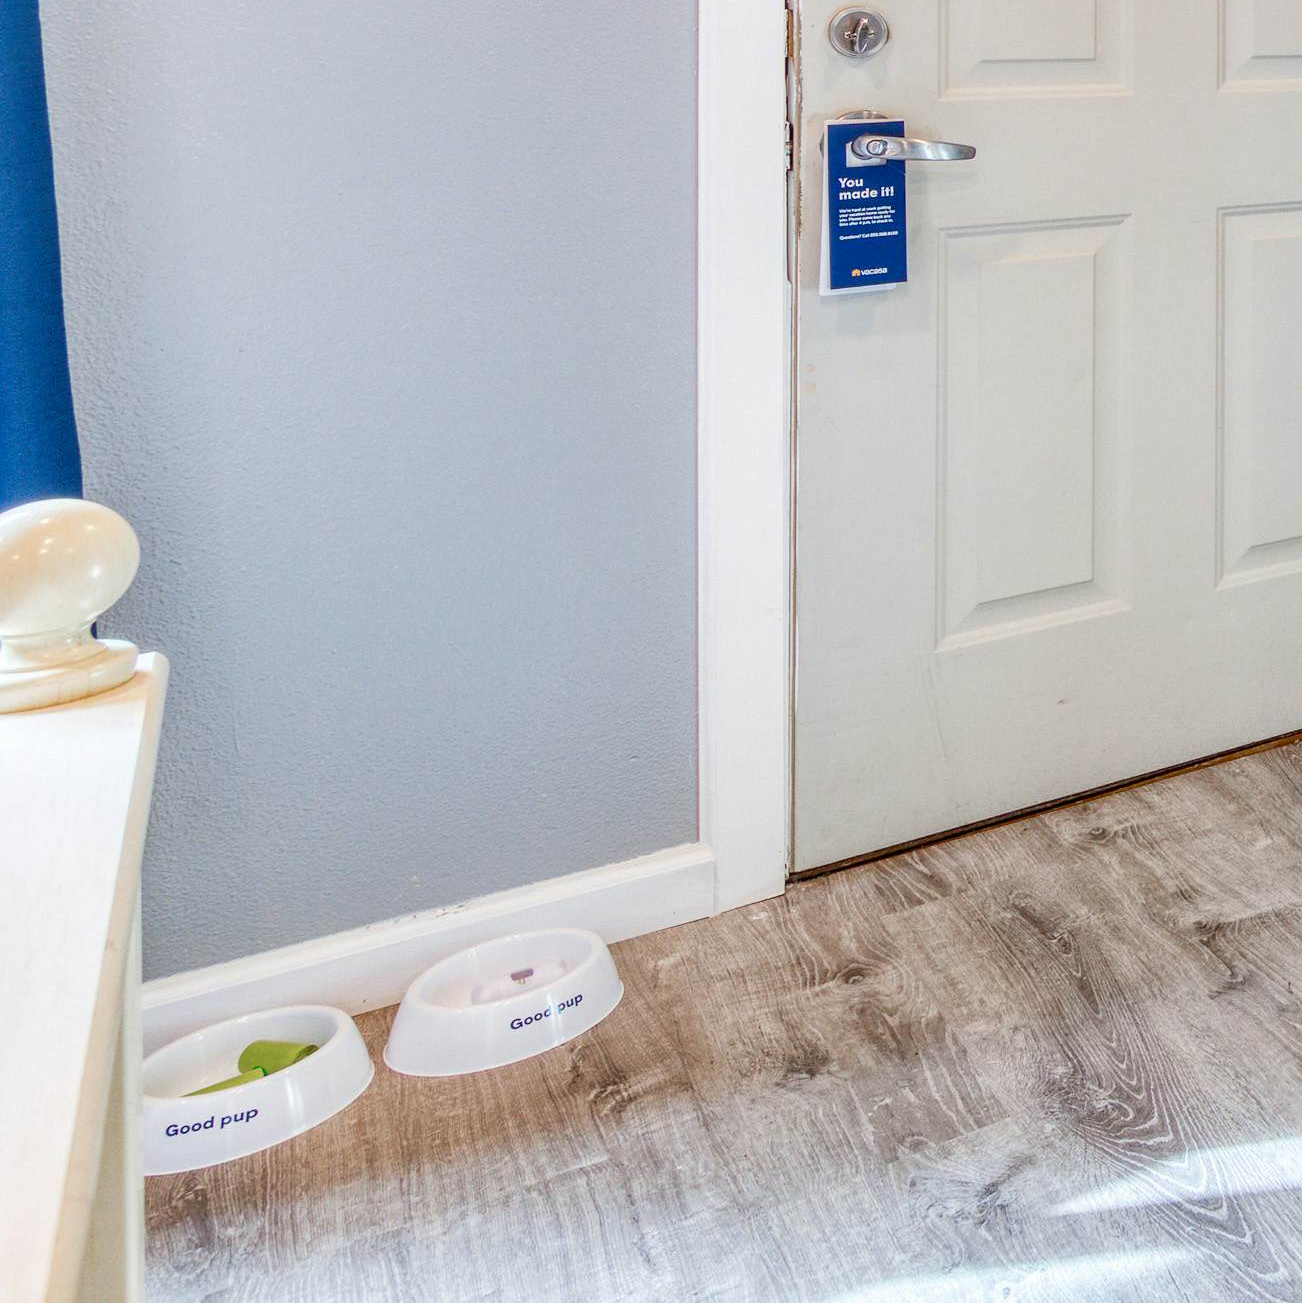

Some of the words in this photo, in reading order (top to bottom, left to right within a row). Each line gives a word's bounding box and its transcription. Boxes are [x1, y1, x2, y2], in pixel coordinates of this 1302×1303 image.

[838, 177, 864, 188] You
[839, 188, 878, 201] made
[881, 186, 894, 197] it!
[861, 267, 887, 276] vacasa
[509, 1006, 555, 1031] Good
[556, 993, 584, 1015] pup
[165, 1116, 214, 1139] Good
[220, 1107, 259, 1128] pup
